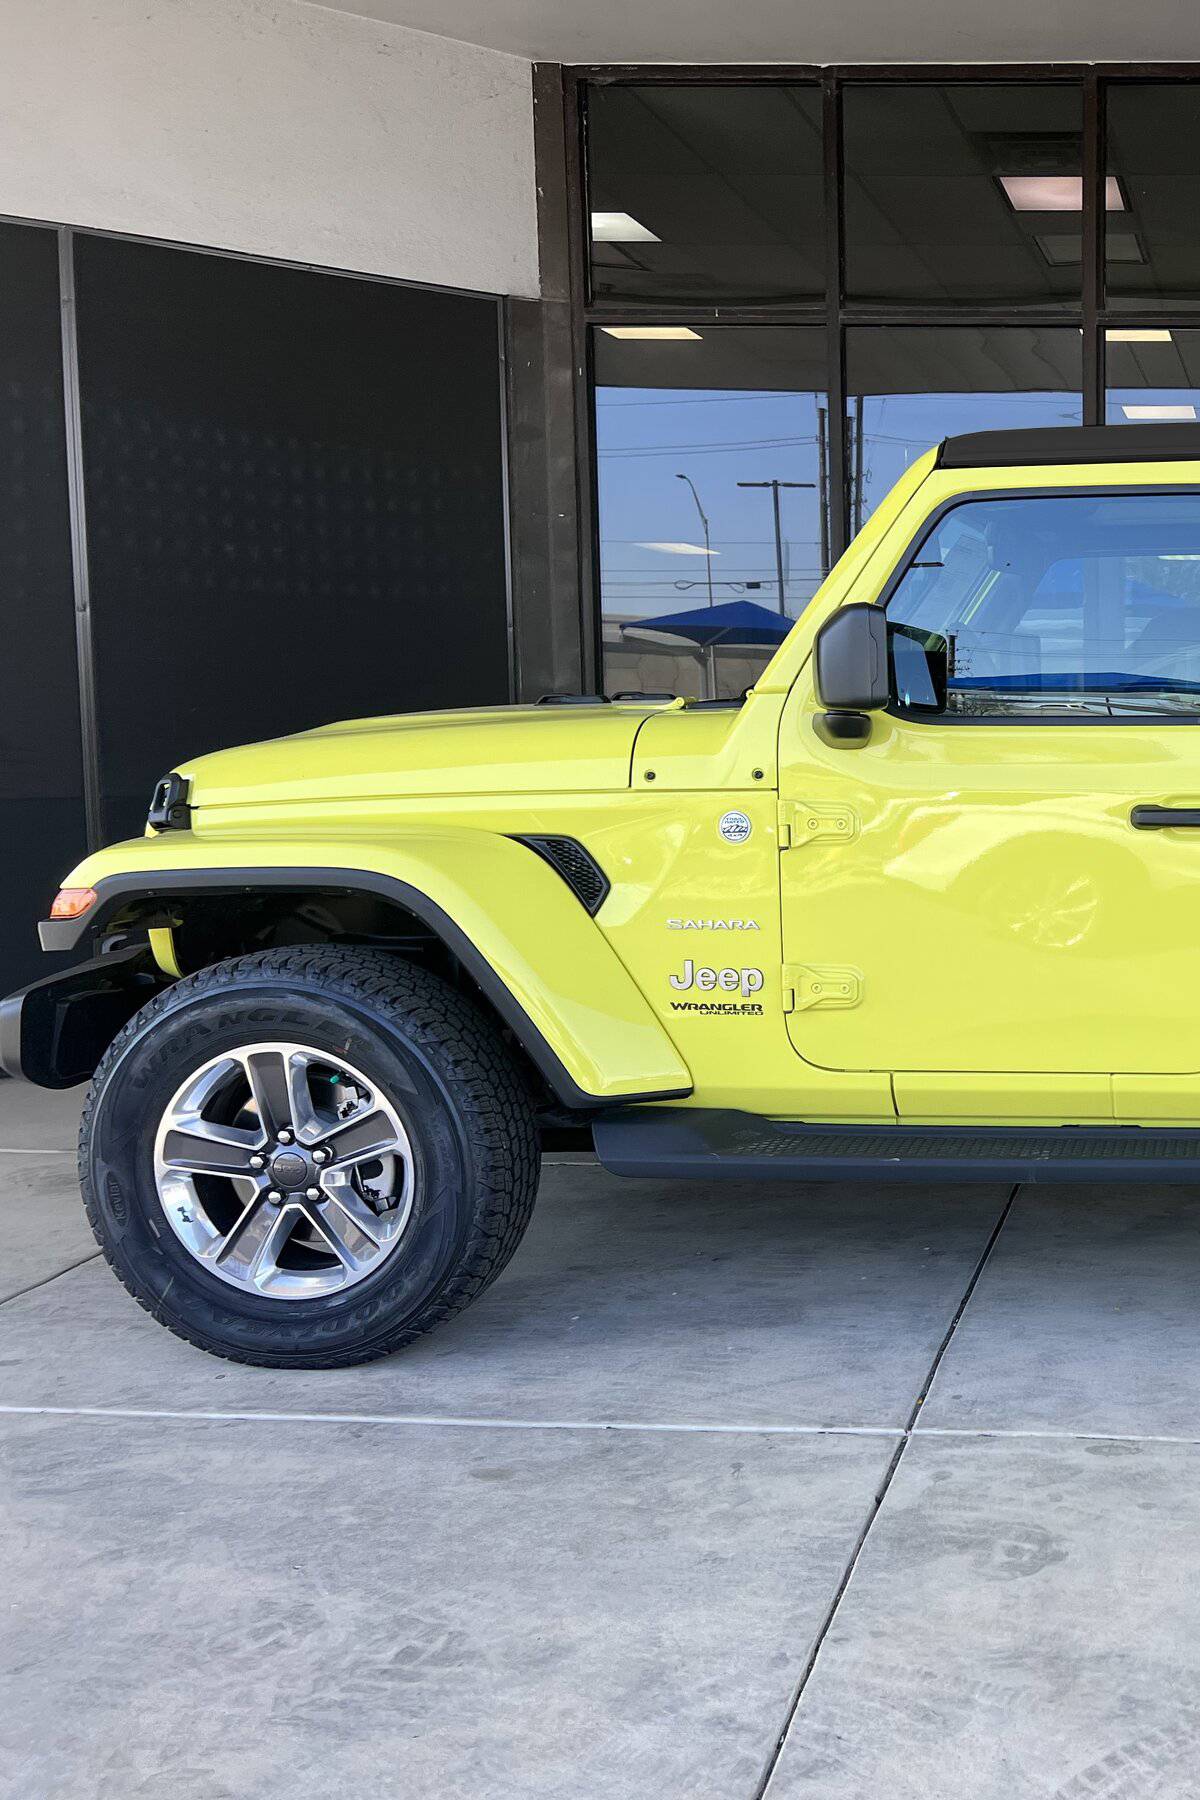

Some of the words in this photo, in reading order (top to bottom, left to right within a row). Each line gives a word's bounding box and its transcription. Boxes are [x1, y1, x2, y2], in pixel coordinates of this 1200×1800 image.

[666, 918, 760, 931] SAHARA
[669, 959, 764, 997] Jeep
[670, 1002, 763, 1011] WRANGLER
[132, 1006, 376, 1091] WRANGLER
[107, 1179, 128, 1221] Kevlar
